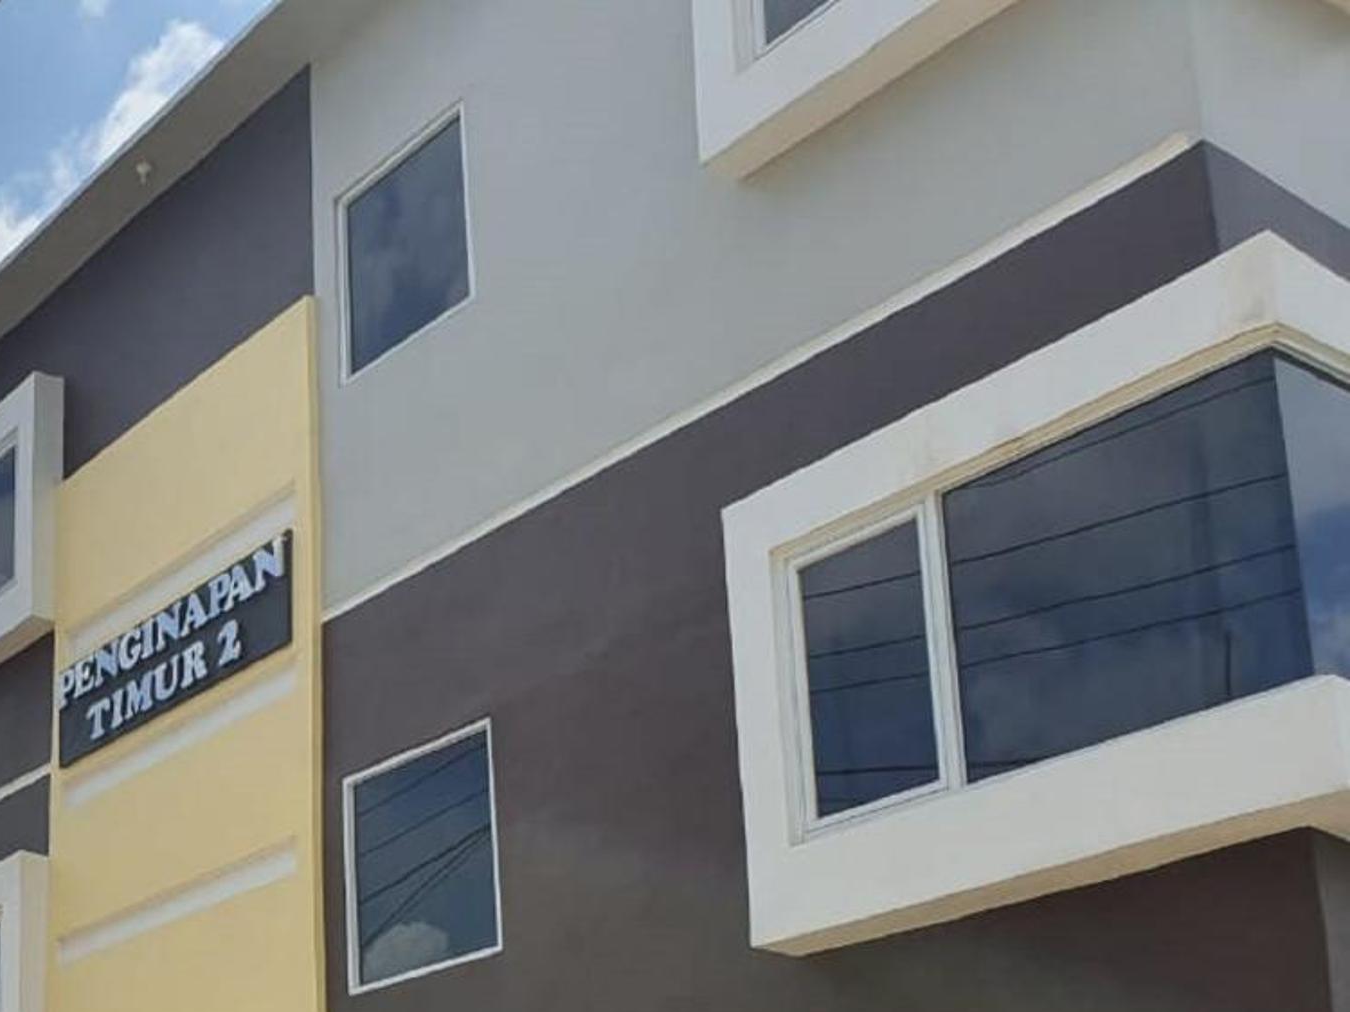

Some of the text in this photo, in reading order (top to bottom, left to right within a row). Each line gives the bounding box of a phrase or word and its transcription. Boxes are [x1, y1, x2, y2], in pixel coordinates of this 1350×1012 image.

[56, 535, 286, 707] PENGINAPAN
[86, 619, 242, 741] TIMUR 2
